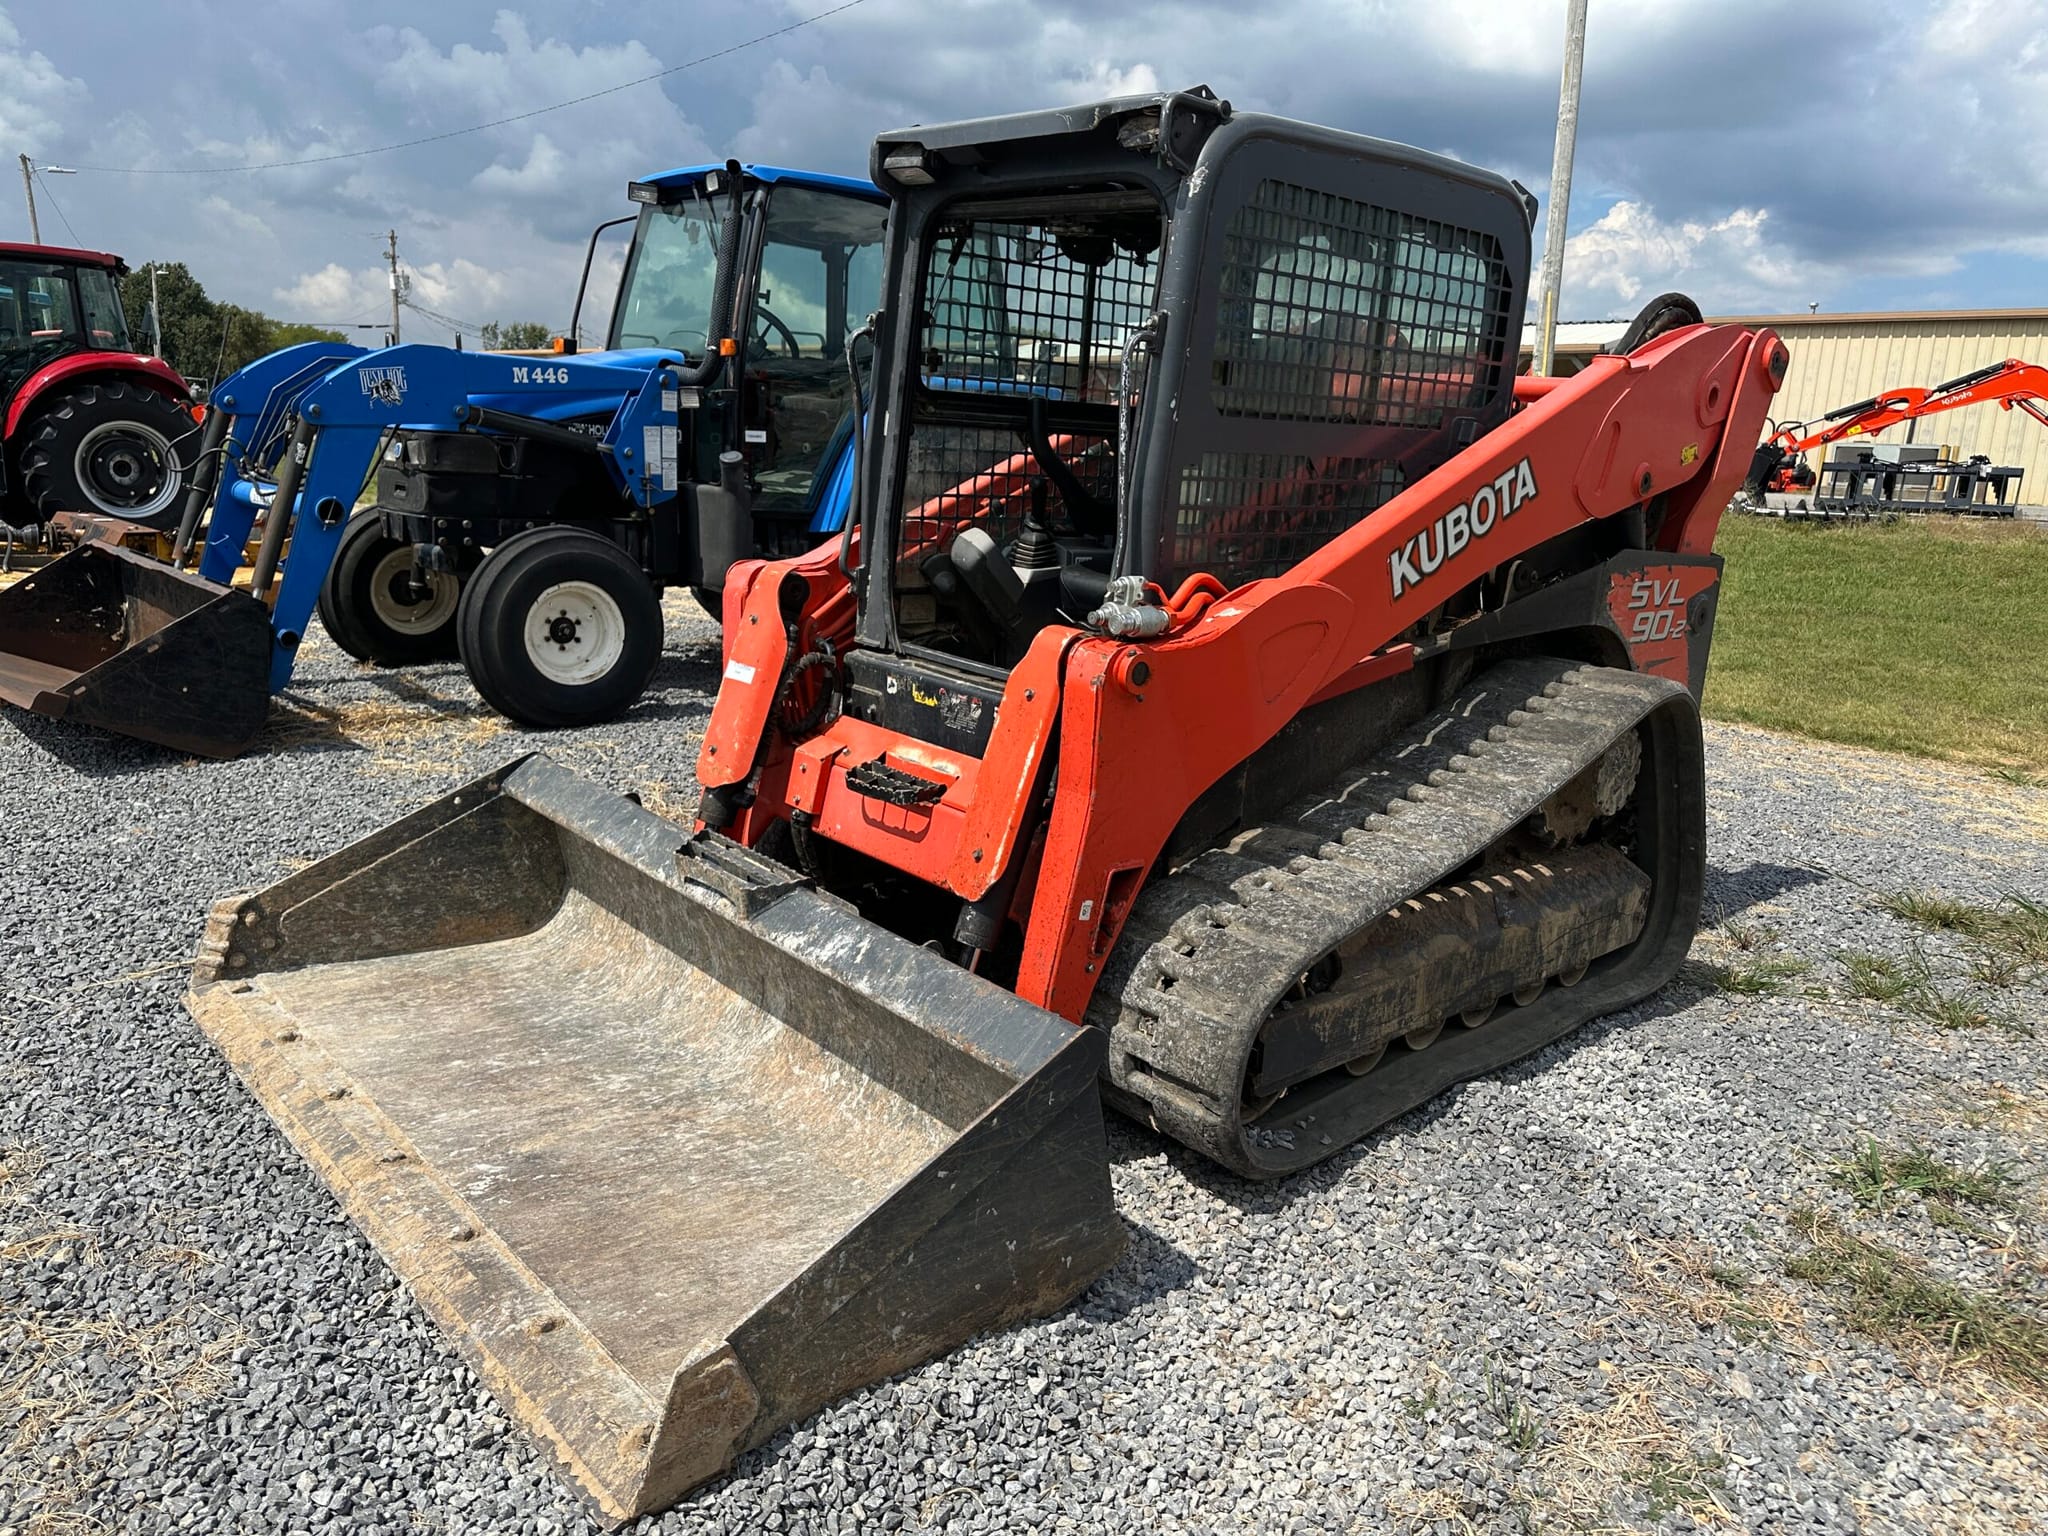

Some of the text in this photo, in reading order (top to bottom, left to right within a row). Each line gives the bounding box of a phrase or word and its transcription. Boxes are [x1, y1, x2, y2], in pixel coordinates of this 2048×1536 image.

[512, 367, 569, 384] M 446
[1389, 457, 1538, 599] KUBOTA
[1627, 579, 1685, 608] SVL
